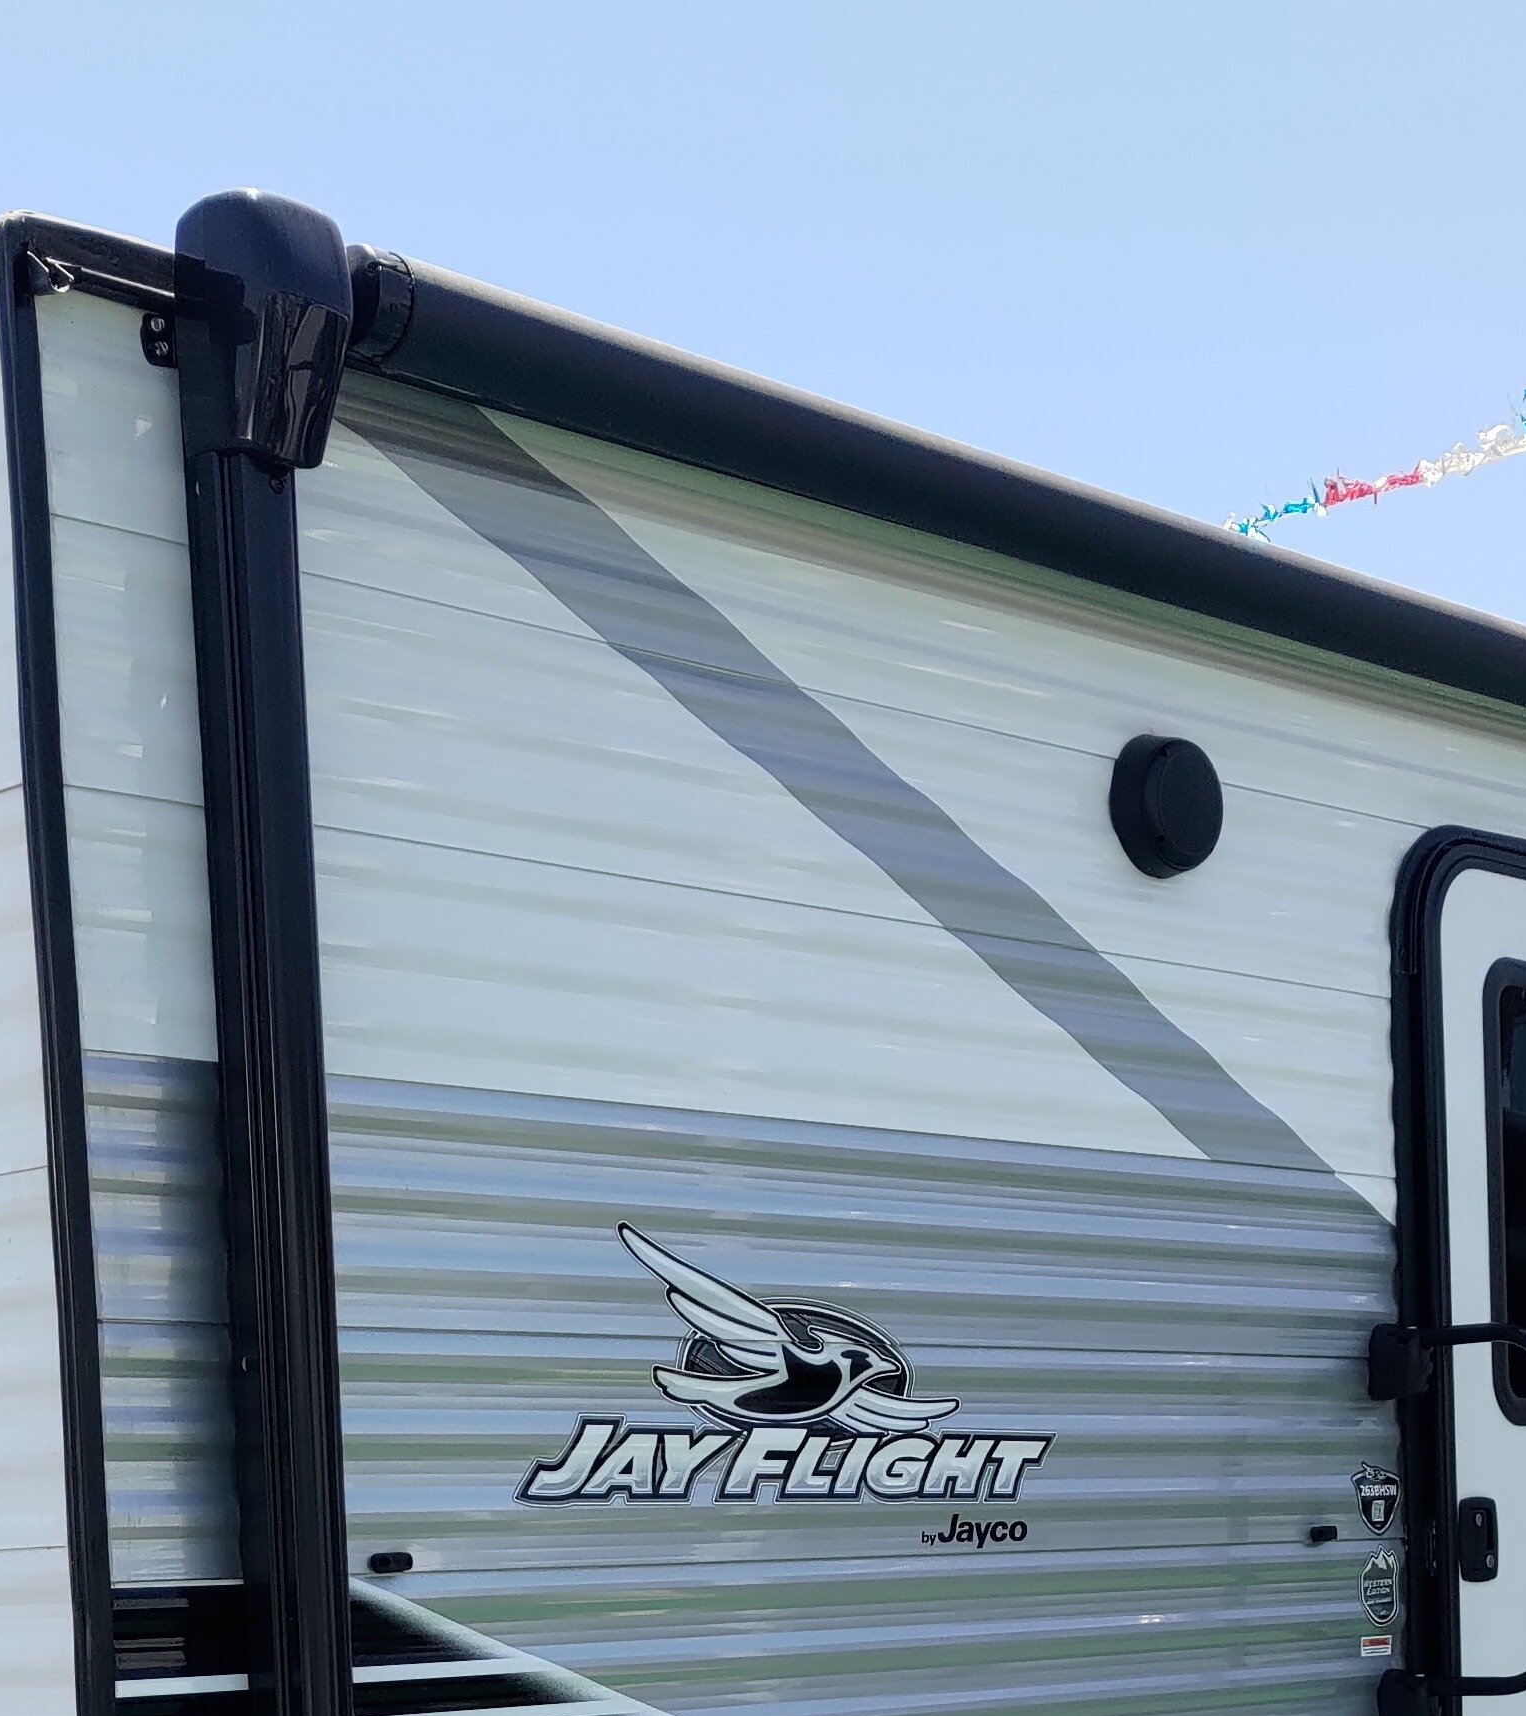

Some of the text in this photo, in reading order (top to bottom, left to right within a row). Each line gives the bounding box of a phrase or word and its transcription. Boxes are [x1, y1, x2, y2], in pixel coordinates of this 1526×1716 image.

[519, 1416, 1056, 1501] JAY FLIGHT
[1359, 1485, 1397, 1497] 263BHSW
[921, 1513, 1028, 1549] by Jayco
